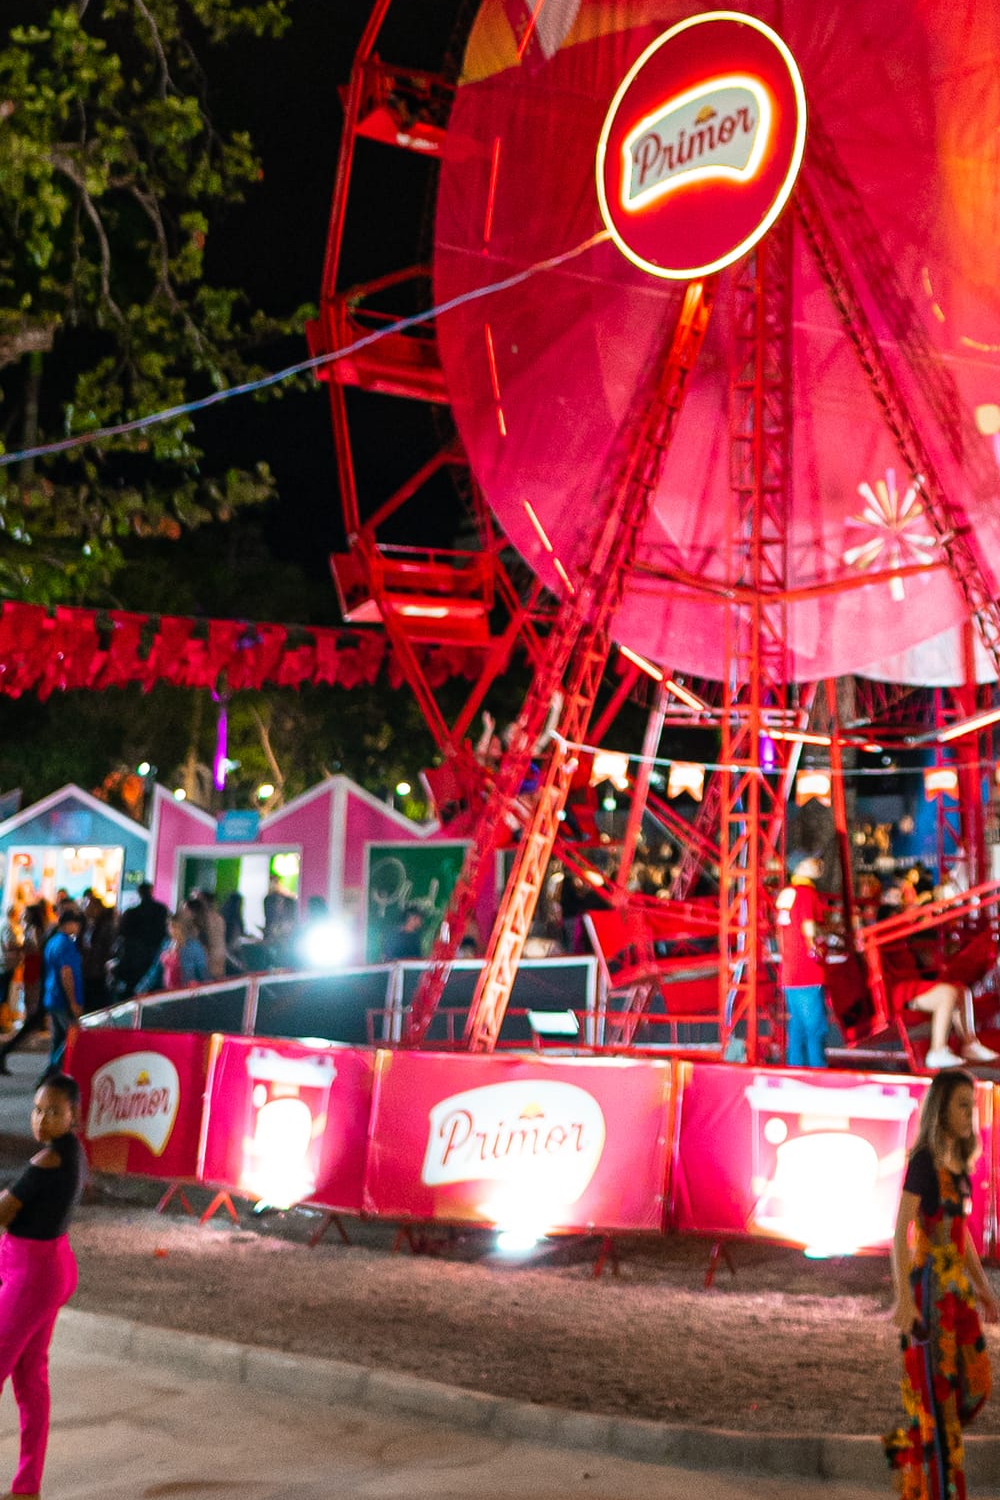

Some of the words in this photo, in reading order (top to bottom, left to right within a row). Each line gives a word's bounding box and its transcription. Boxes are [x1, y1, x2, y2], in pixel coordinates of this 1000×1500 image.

[633, 106, 755, 186] Primor
[94, 1074, 170, 1126] Primor
[438, 1109, 591, 1167] Primor
